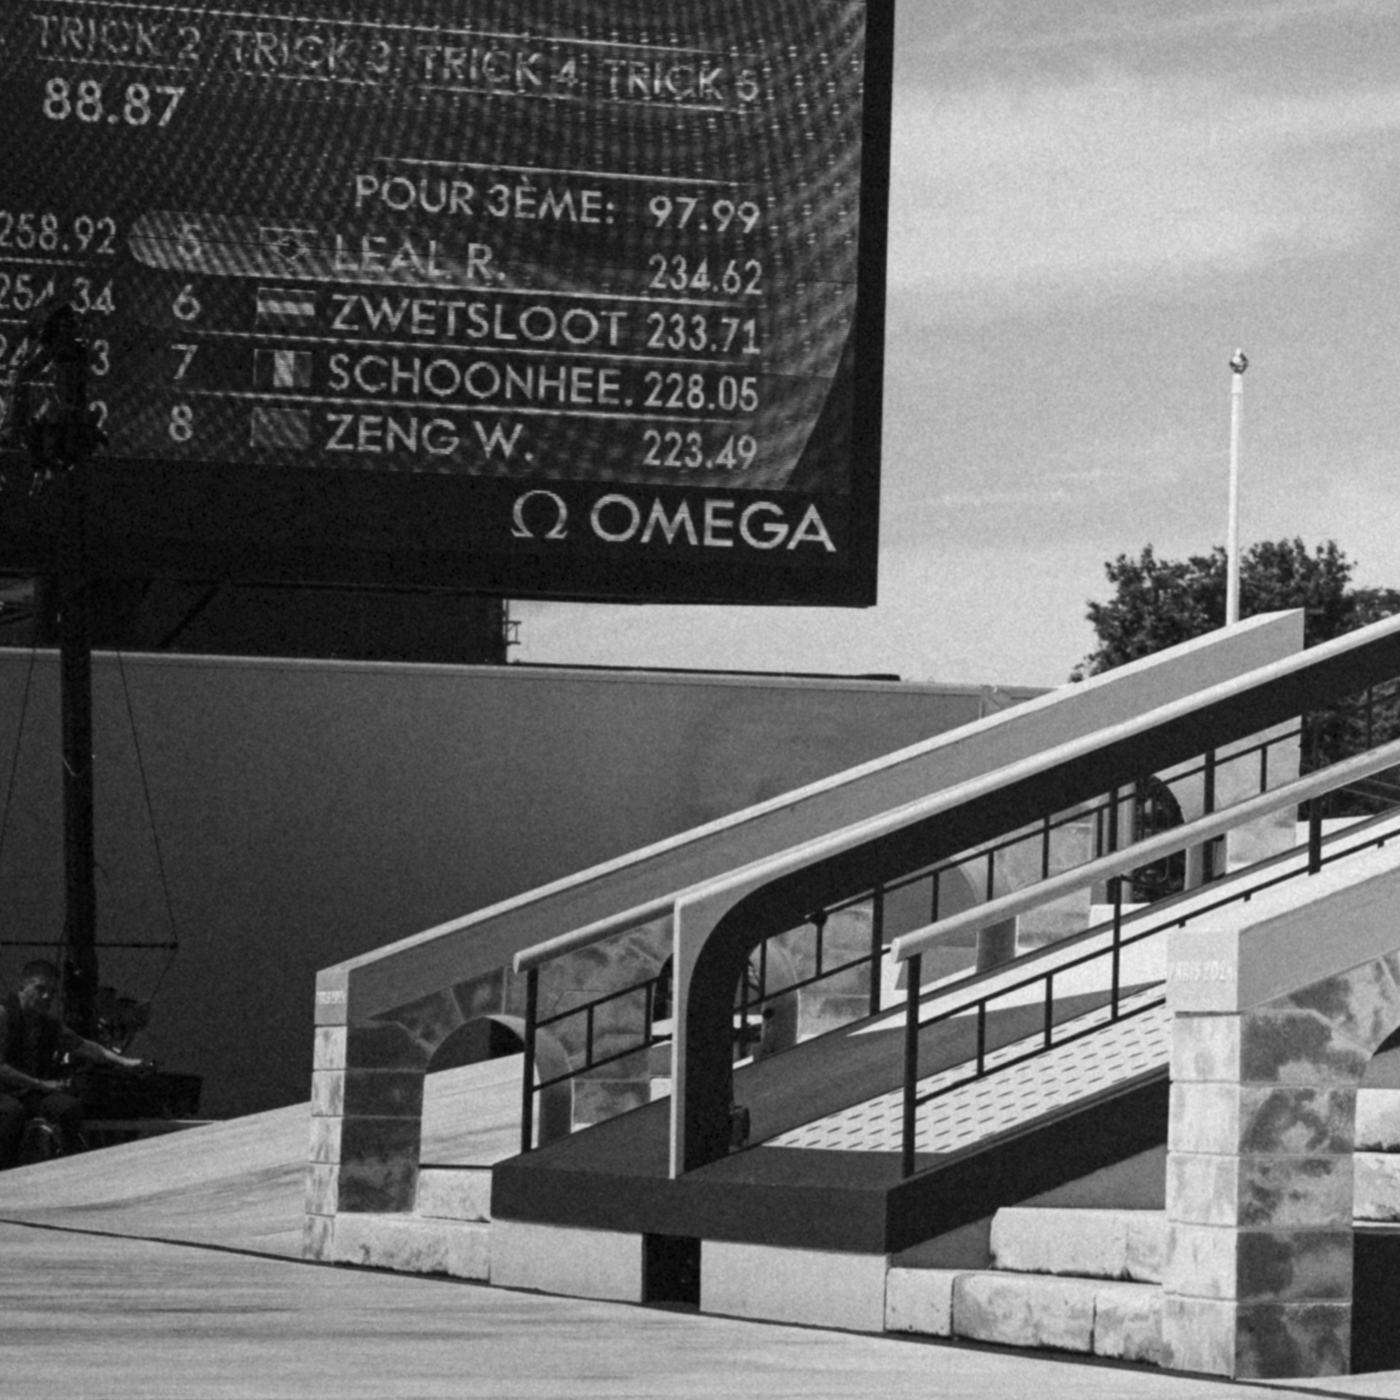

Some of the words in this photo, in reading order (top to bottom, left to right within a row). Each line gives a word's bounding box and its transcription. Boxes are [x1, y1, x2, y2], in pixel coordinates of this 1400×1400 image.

[31, 13, 164, 57] TRICK
[177, 27, 201, 61] 2
[227, 29, 356, 71] TRICK
[365, 40, 391, 74] 3
[416, 45, 543, 87] TRICK
[552, 57, 578, 87] 4
[603, 59, 725, 102] TRICK
[736, 69, 760, 102] 5
[43, 77, 186, 127] 88.87
[355, 174, 474, 216] POUR
[487, 173, 615, 225] 3ÈME:
[649, 195, 761, 234] 97.99
[0, 209, 117, 255] 258.92
[177, 223, 202, 263] 5
[335, 233, 450, 278] LEAL
[467, 242, 506, 281] R.
[648, 253, 763, 296] 234.62
[171, 283, 201, 321] 6
[330, 293, 629, 347] ZWETSLOOT
[646, 311, 761, 355] 233.71
[171, 343, 199, 380] 7
[328, 352, 633, 408] SCHOONHEE.
[643, 371, 759, 413] 228.05
[168, 404, 194, 442] 8
[325, 411, 461, 456] ZENG
[473, 418, 535, 462] W.
[641, 429, 758, 471] 223.49
[590, 493, 838, 553] OMEGA
